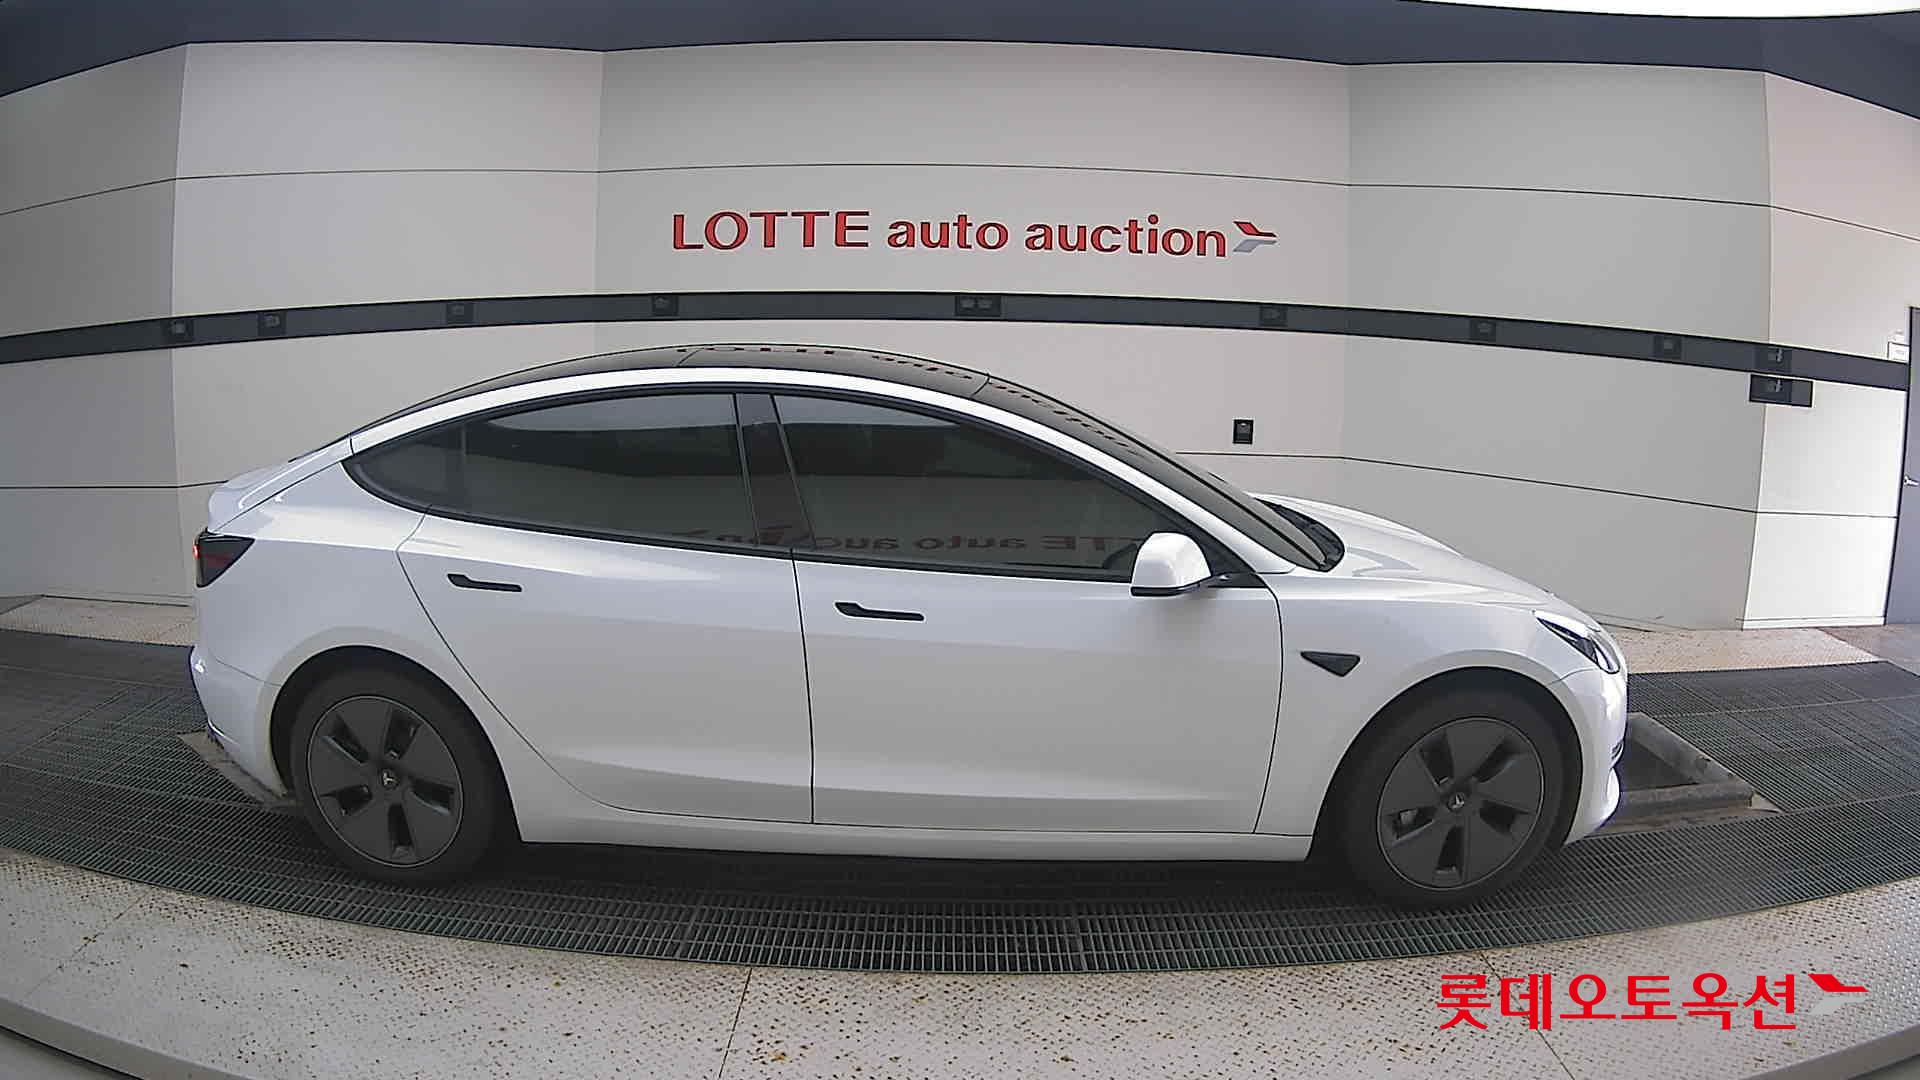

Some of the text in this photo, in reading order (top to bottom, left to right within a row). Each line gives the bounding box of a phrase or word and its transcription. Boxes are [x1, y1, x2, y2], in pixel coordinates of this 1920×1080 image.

[673, 210, 1227, 258] LOTTE auto auction
